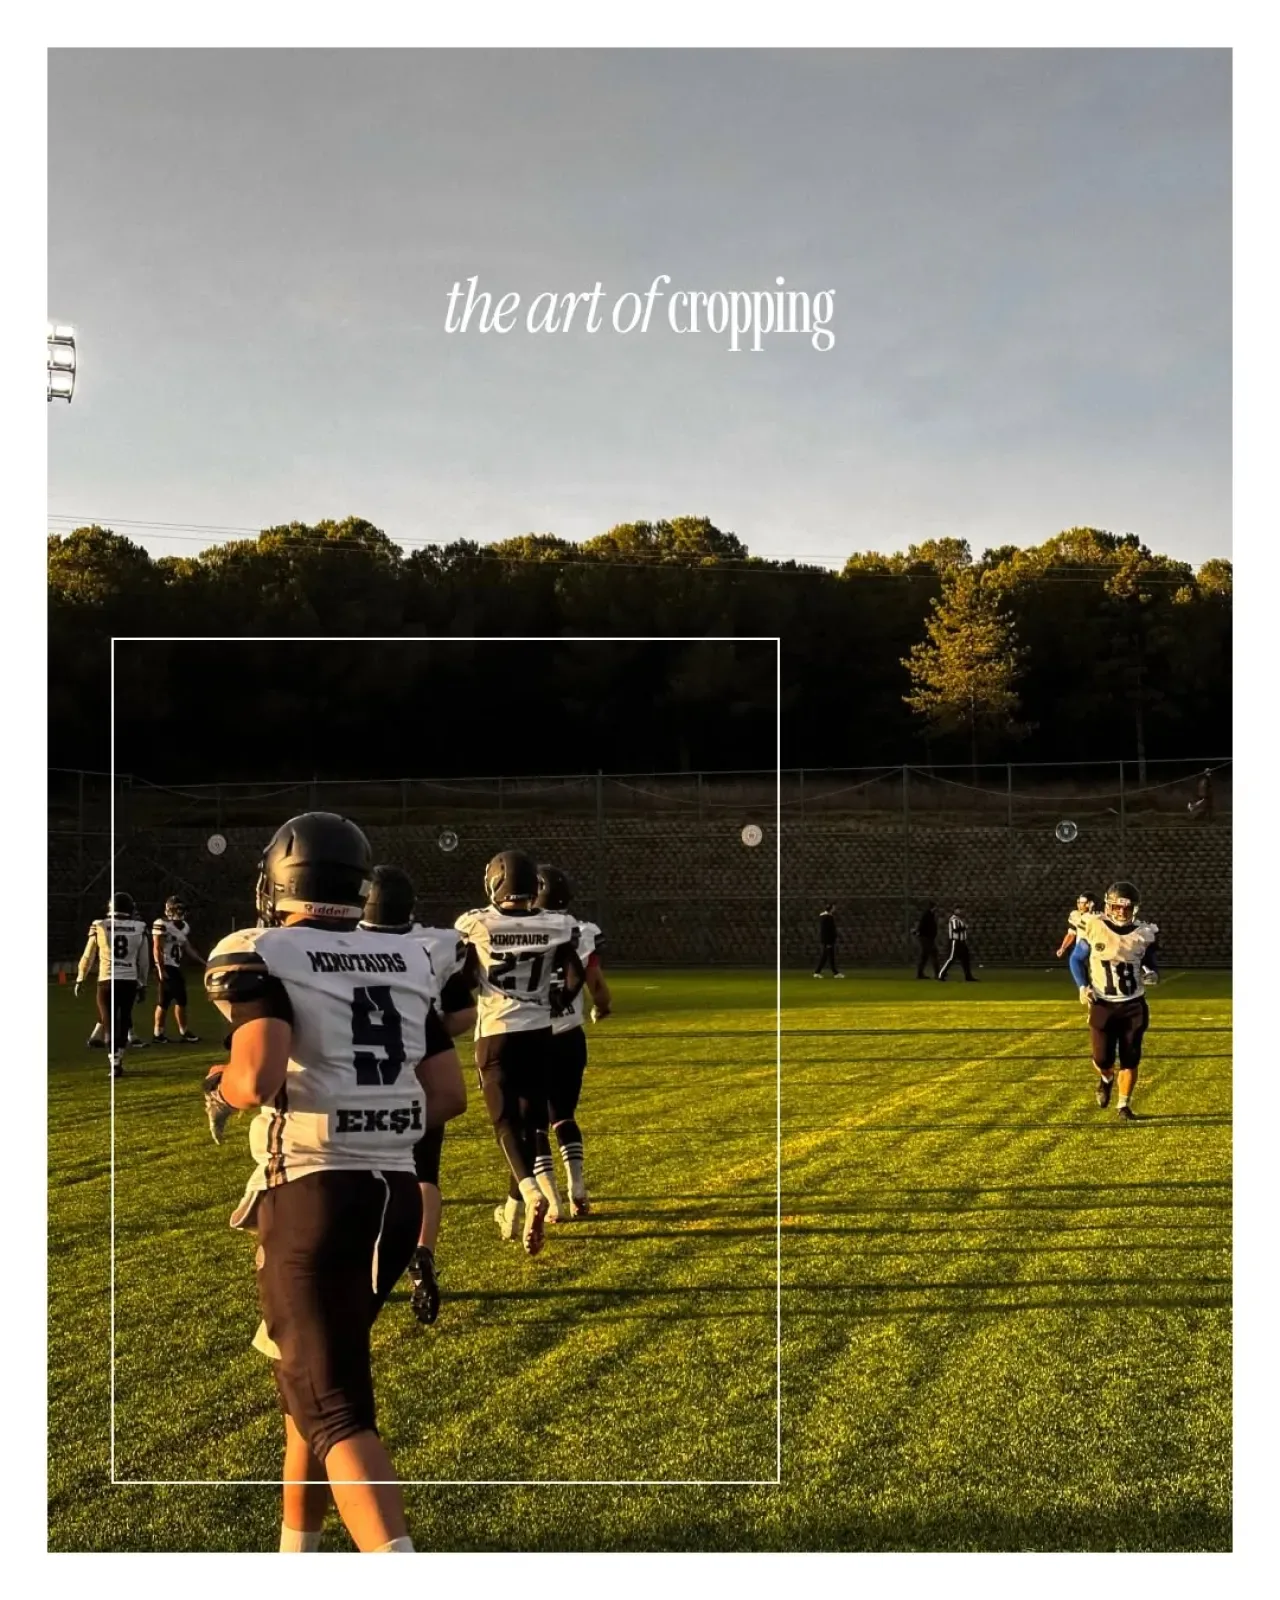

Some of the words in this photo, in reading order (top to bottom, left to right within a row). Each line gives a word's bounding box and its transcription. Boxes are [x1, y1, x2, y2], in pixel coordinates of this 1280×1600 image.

[112, 934, 129, 959] 8
[489, 934, 549, 945] MINOTAURS
[306, 951, 407, 973] MINOTAURS
[487, 951, 545, 993] 27
[1101, 960, 1138, 996] 18
[351, 985, 407, 1086] 9
[335, 1100, 423, 1134] EKŞİ
